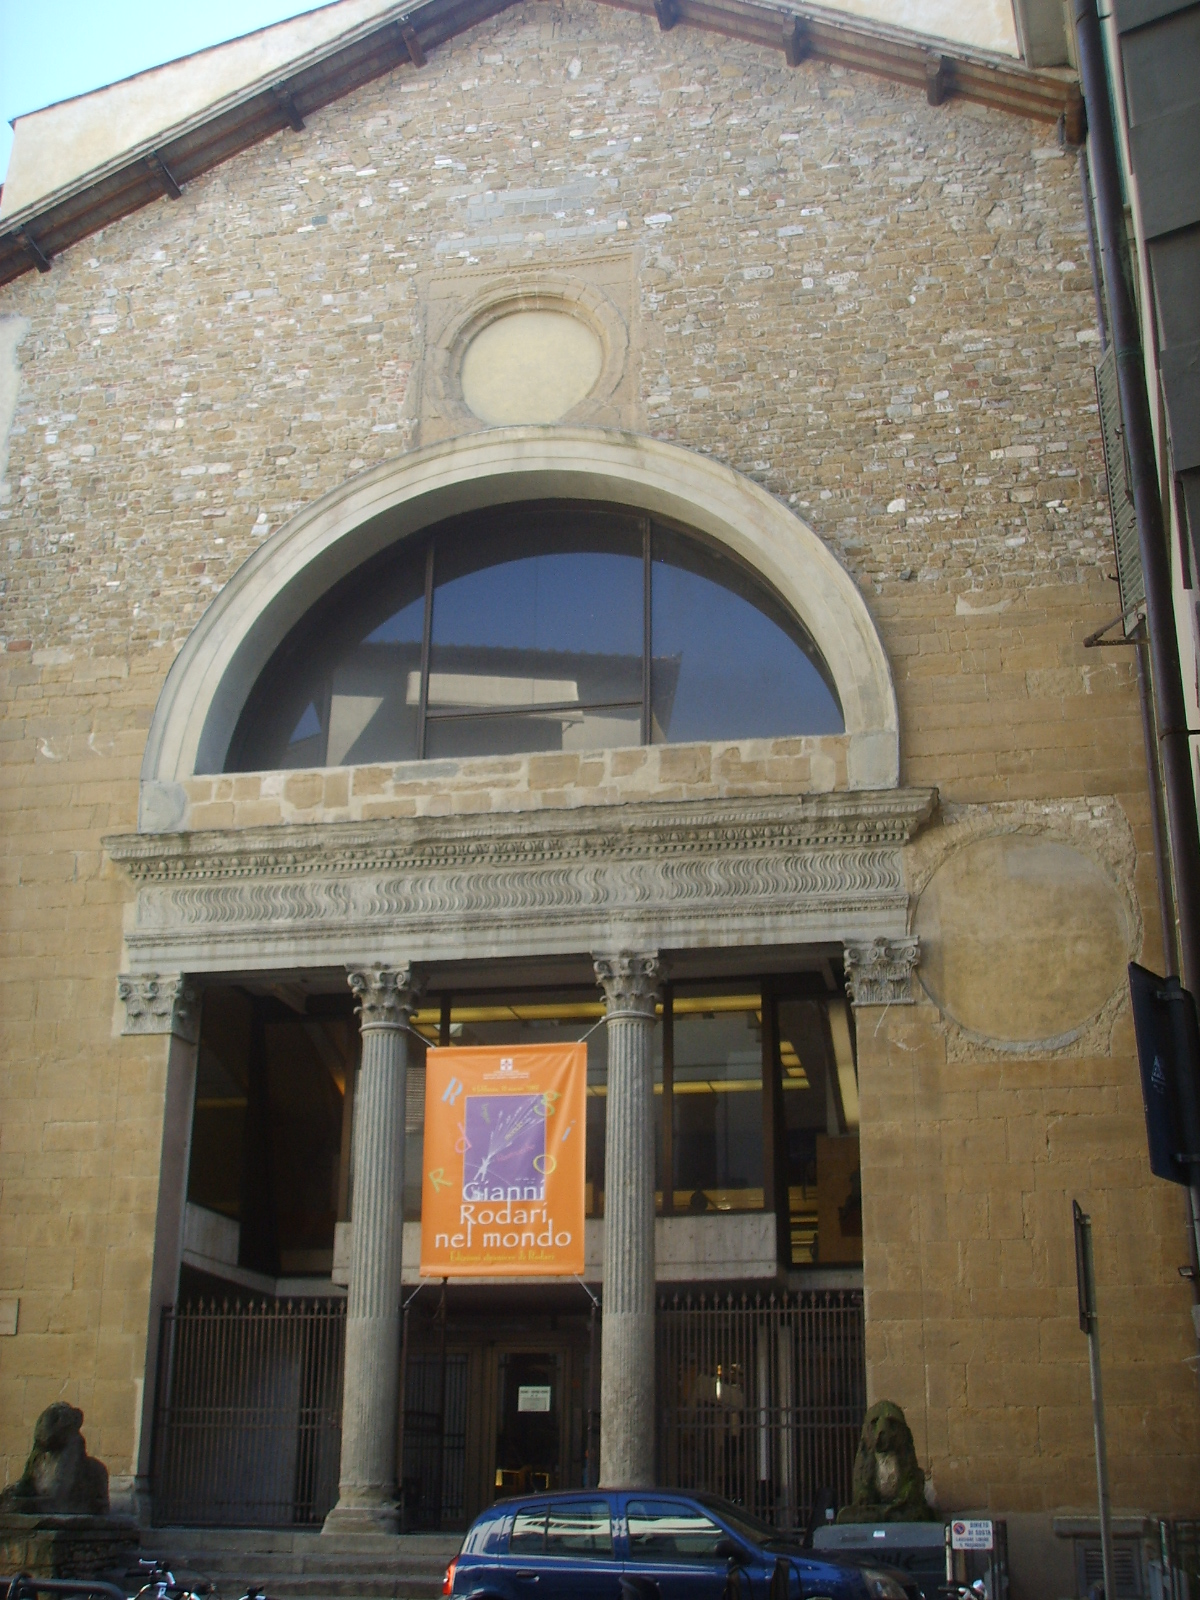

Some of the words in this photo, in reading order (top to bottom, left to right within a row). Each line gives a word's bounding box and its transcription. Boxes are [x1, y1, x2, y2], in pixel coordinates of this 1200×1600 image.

[462, 1179, 546, 1202] Gianni
[459, 1197, 548, 1225] Rodari
[435, 1221, 473, 1248] nel
[482, 1217, 572, 1248] mondo
